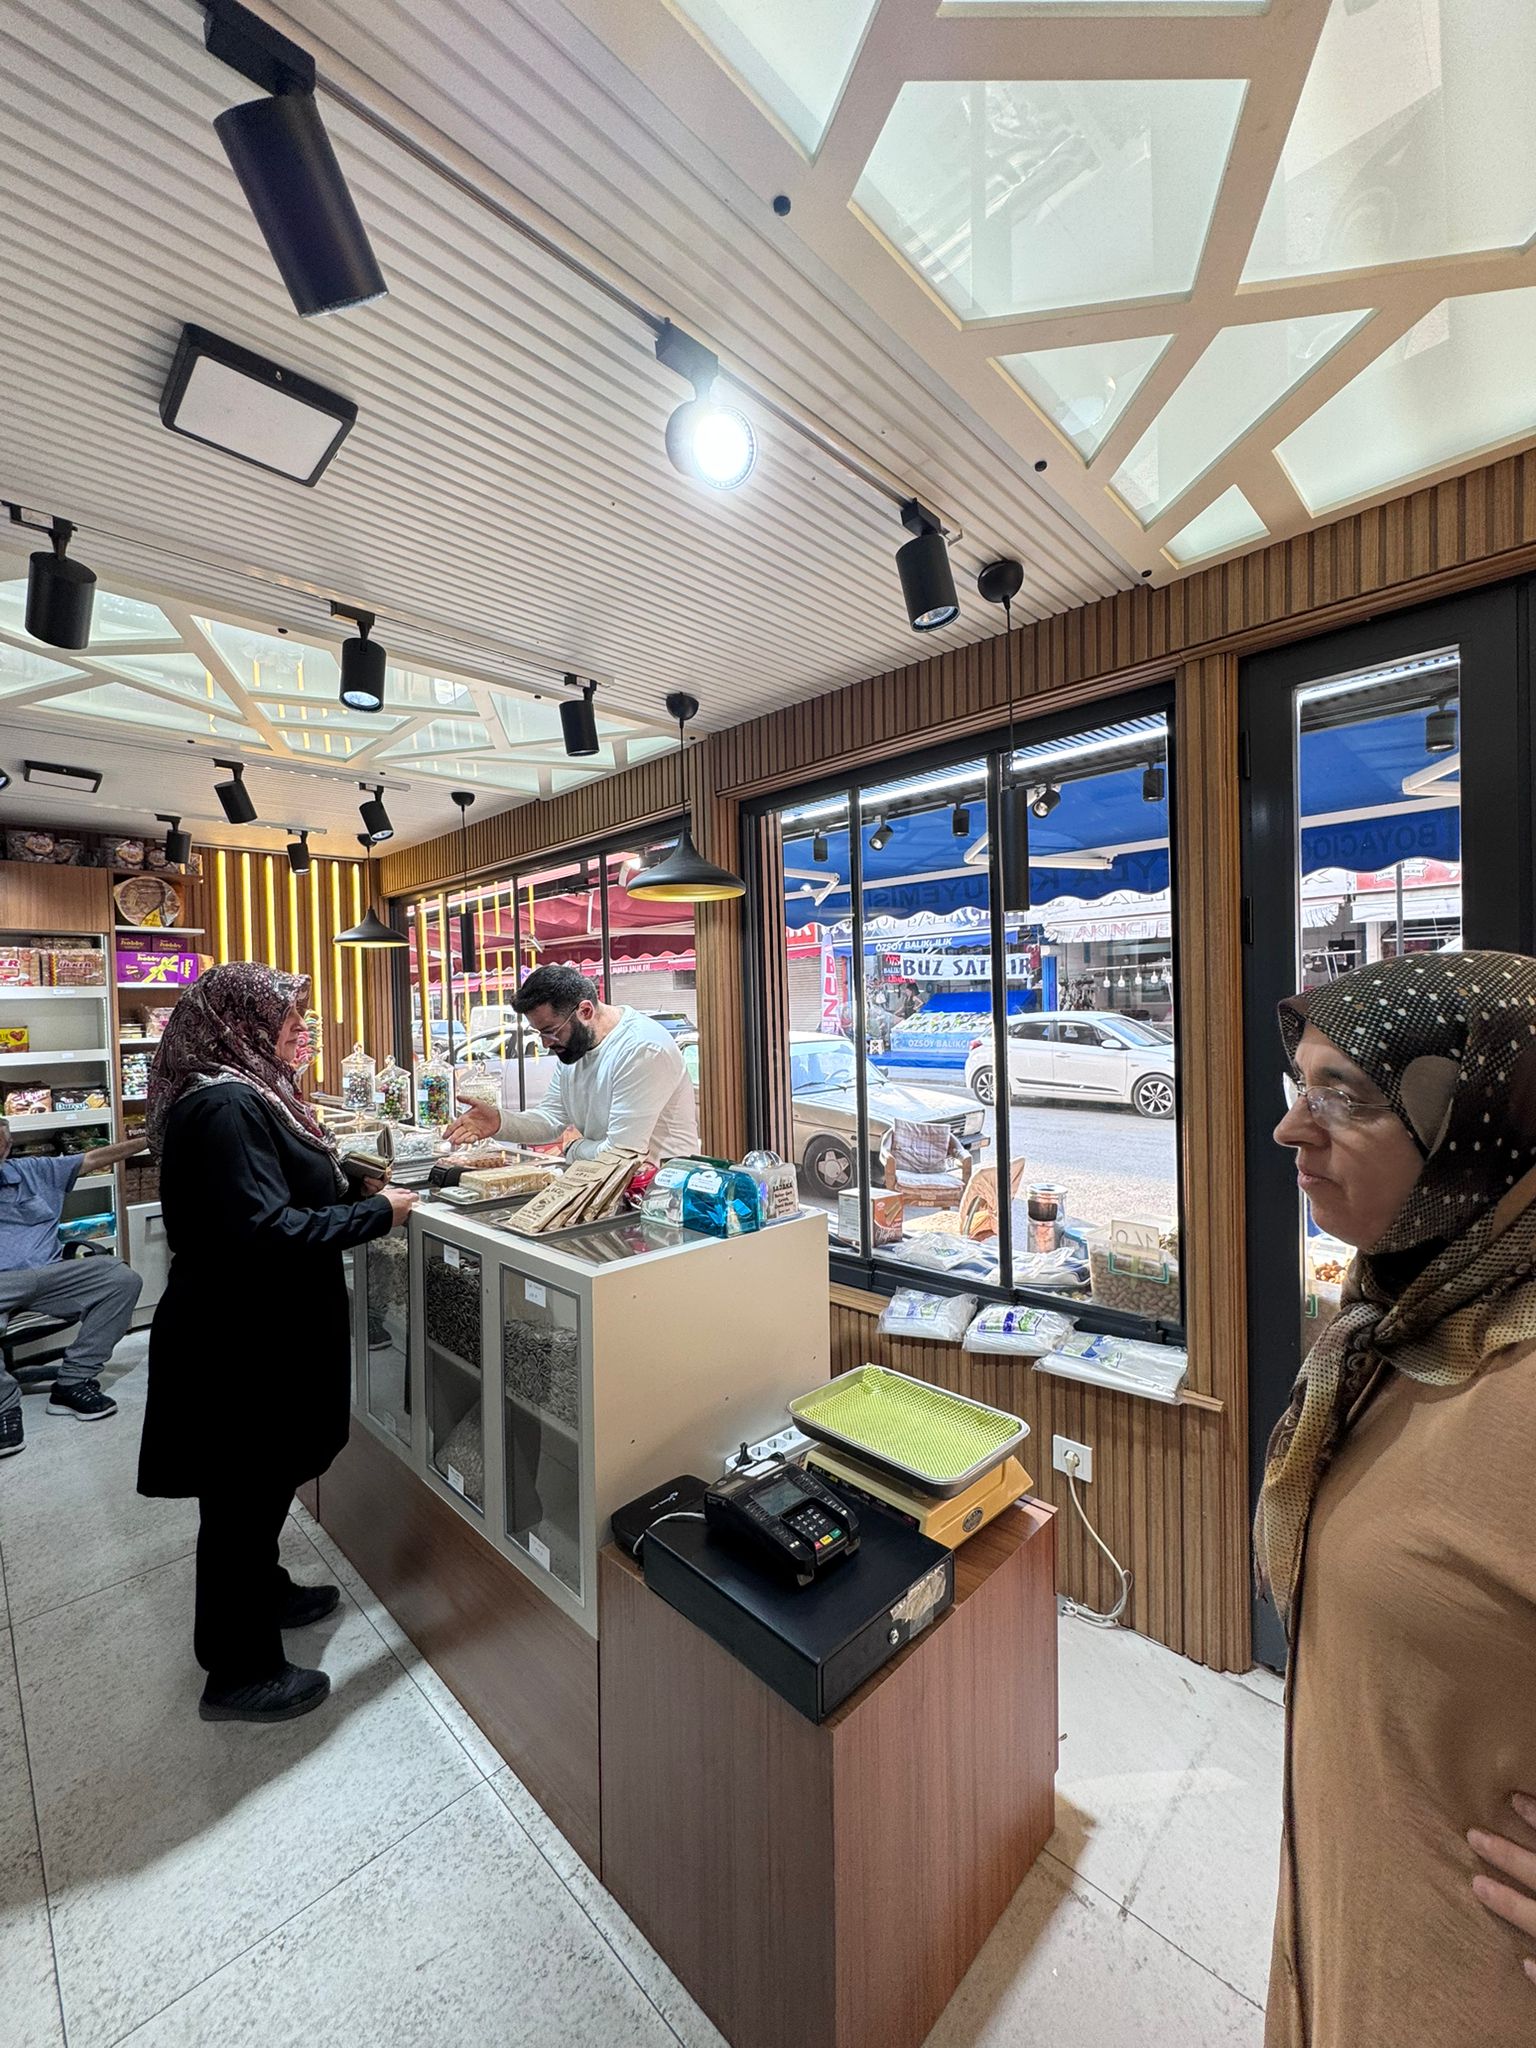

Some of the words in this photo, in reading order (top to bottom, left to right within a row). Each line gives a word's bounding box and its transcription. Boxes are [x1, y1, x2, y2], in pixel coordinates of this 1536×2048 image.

[822, 954, 840, 1018] BUZ
[903, 959, 944, 976] BUZ
[953, 956, 1031, 976] SATIR
